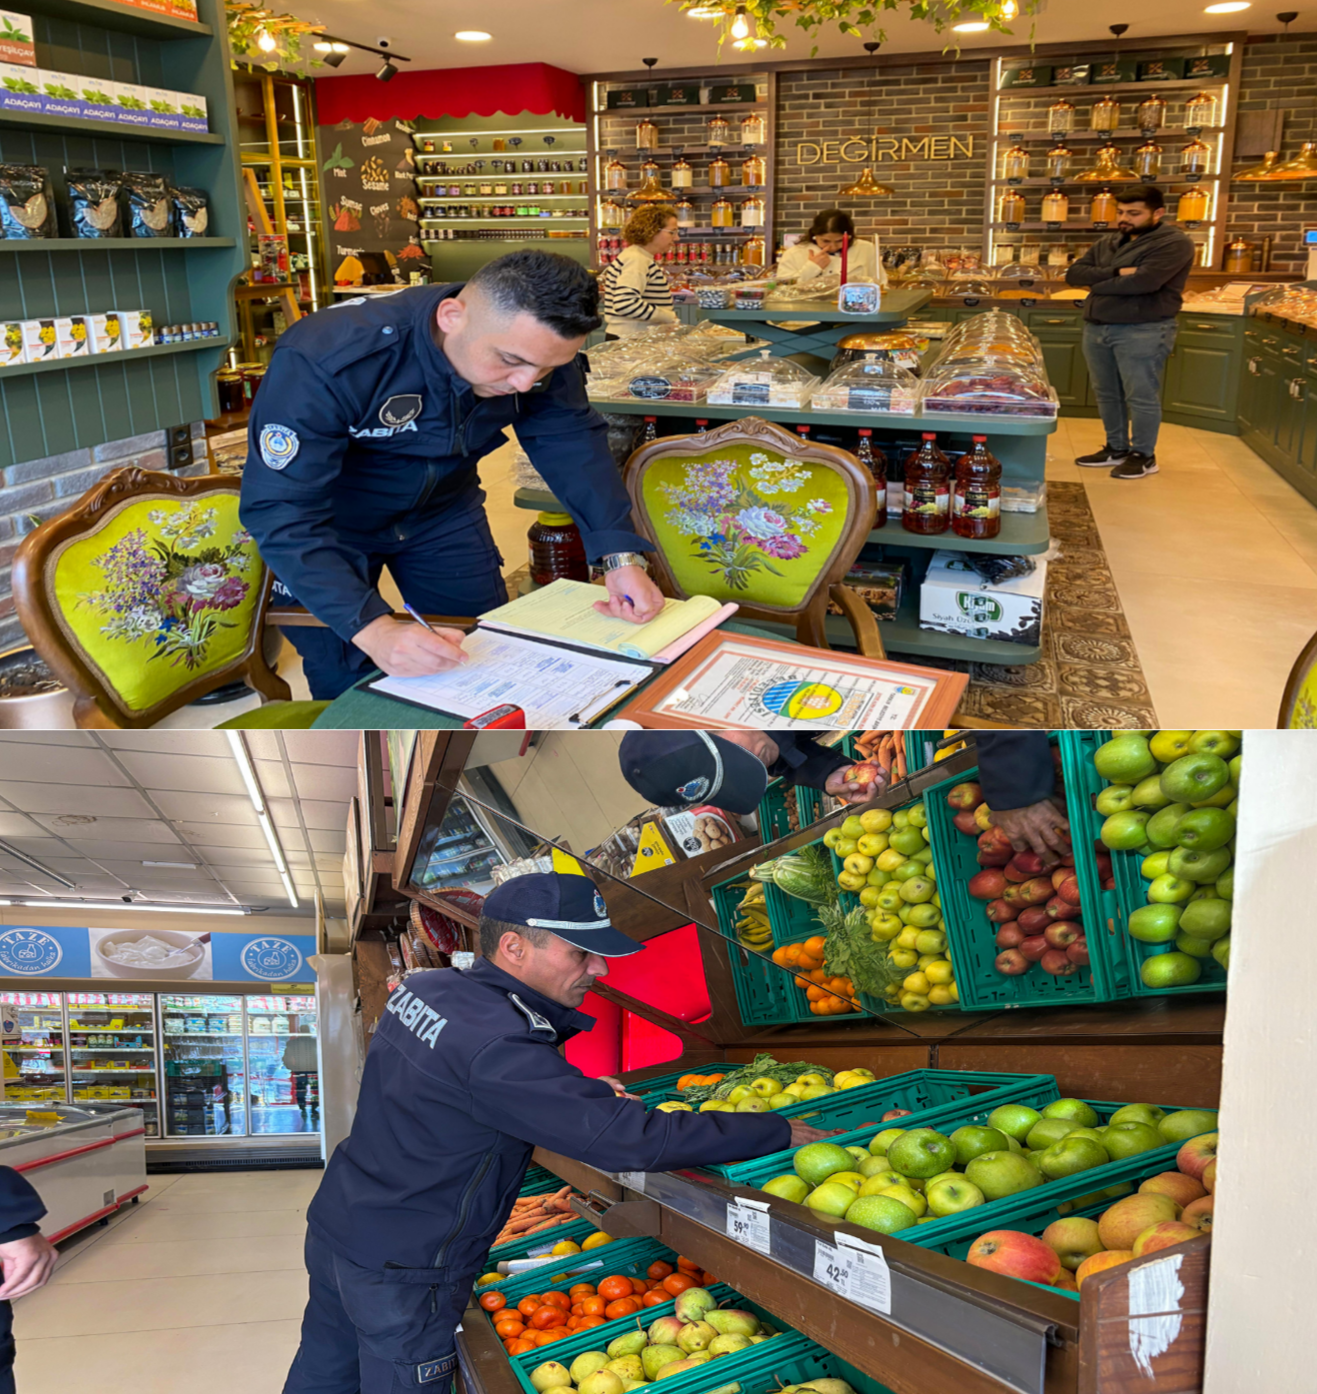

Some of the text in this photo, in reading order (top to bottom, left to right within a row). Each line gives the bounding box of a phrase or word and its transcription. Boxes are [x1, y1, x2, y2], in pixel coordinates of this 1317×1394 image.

[361, 133, 391, 147] Cinnamon
[797, 135, 974, 165] DEĞİRMEN
[333, 167, 347, 178] Mint
[362, 179, 389, 191] Sesame
[369, 203, 389, 216] Cloves
[3, 932, 50, 945] TAZE
[250, 941, 292, 954] TAZE
[386, 983, 449, 1049] ZABITA
